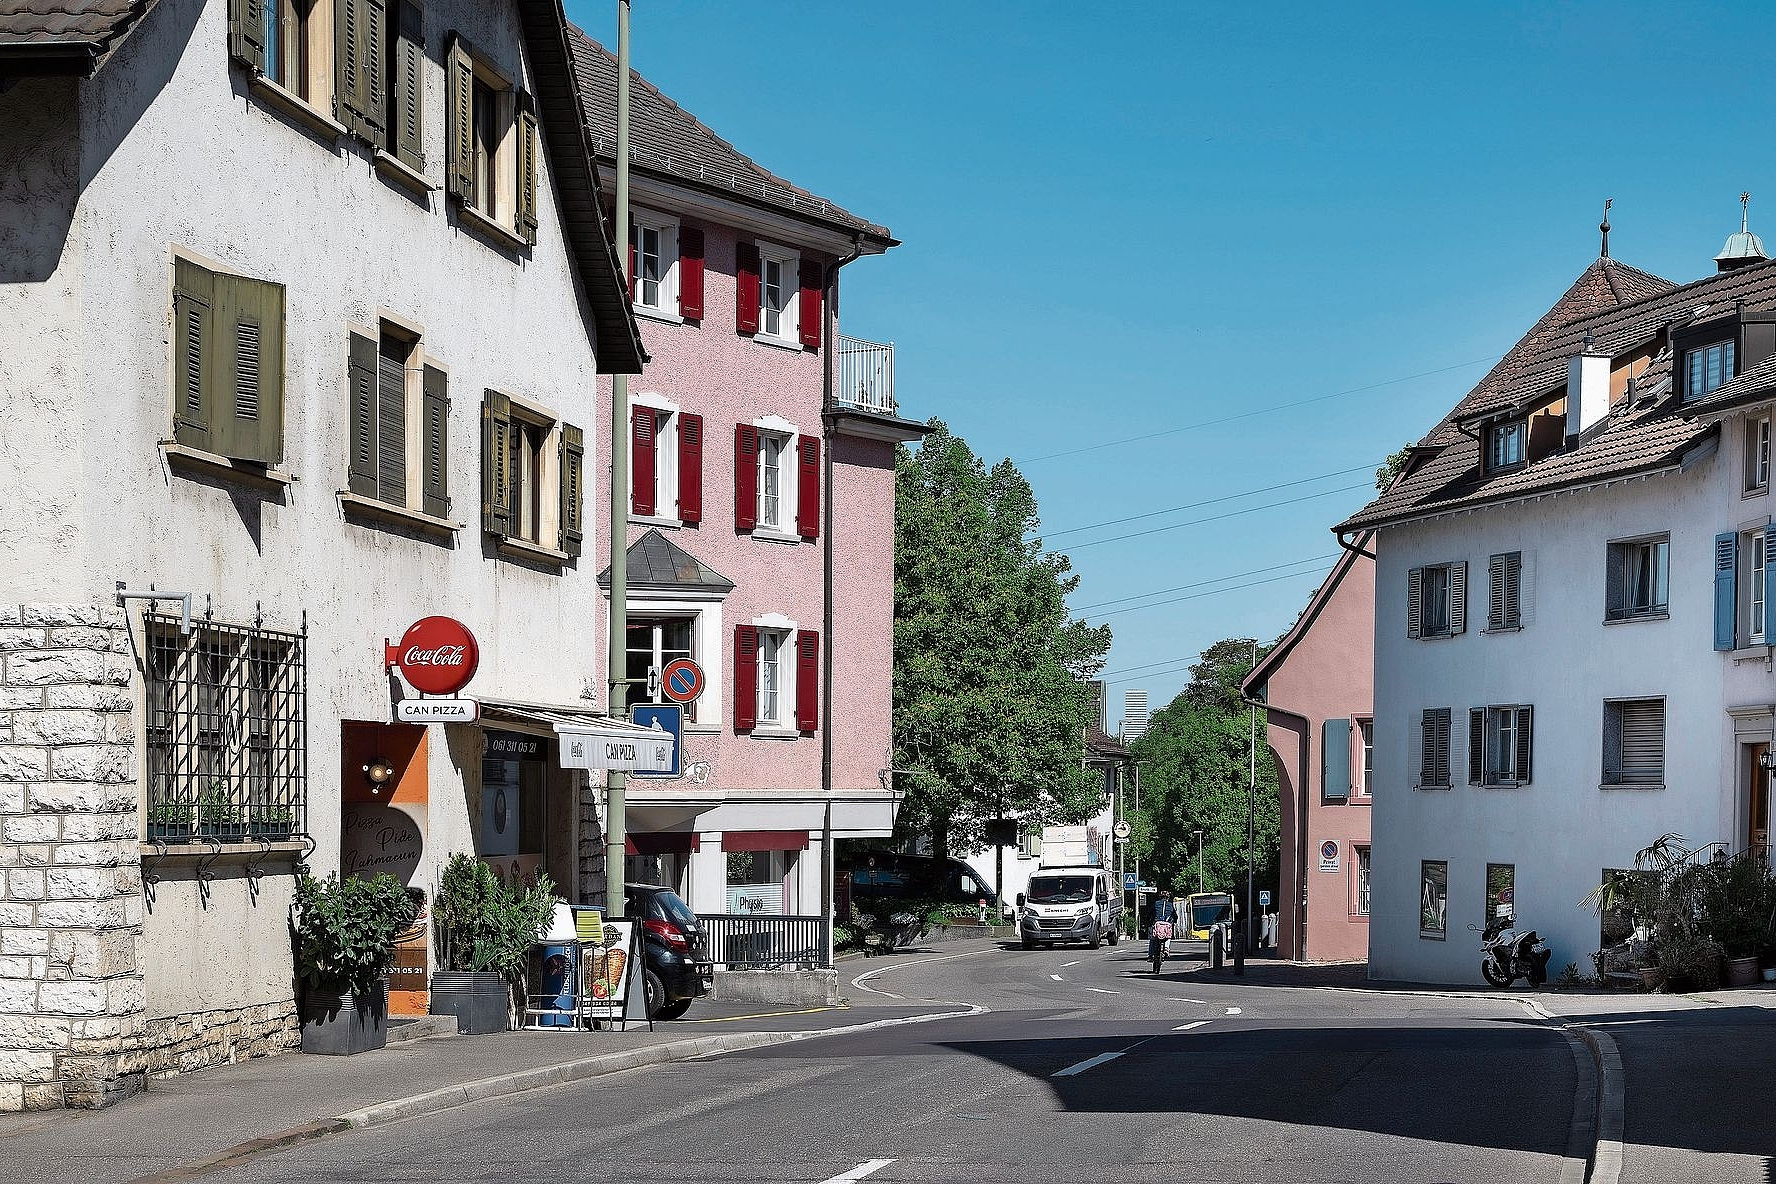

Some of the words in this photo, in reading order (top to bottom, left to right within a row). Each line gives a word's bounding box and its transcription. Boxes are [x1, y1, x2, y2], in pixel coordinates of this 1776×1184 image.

[405, 706, 429, 715] CAN
[432, 706, 466, 715] PIZZA
[492, 739, 506, 751] 061
[506, 740, 518, 752] 311
[518, 742, 528, 753] 05
[528, 742, 537, 753] 21
[605, 742, 619, 760] CAN
[620, 743, 637, 761] PIZZA
[344, 811, 384, 836] Pizza
[375, 826, 415, 852] Pide
